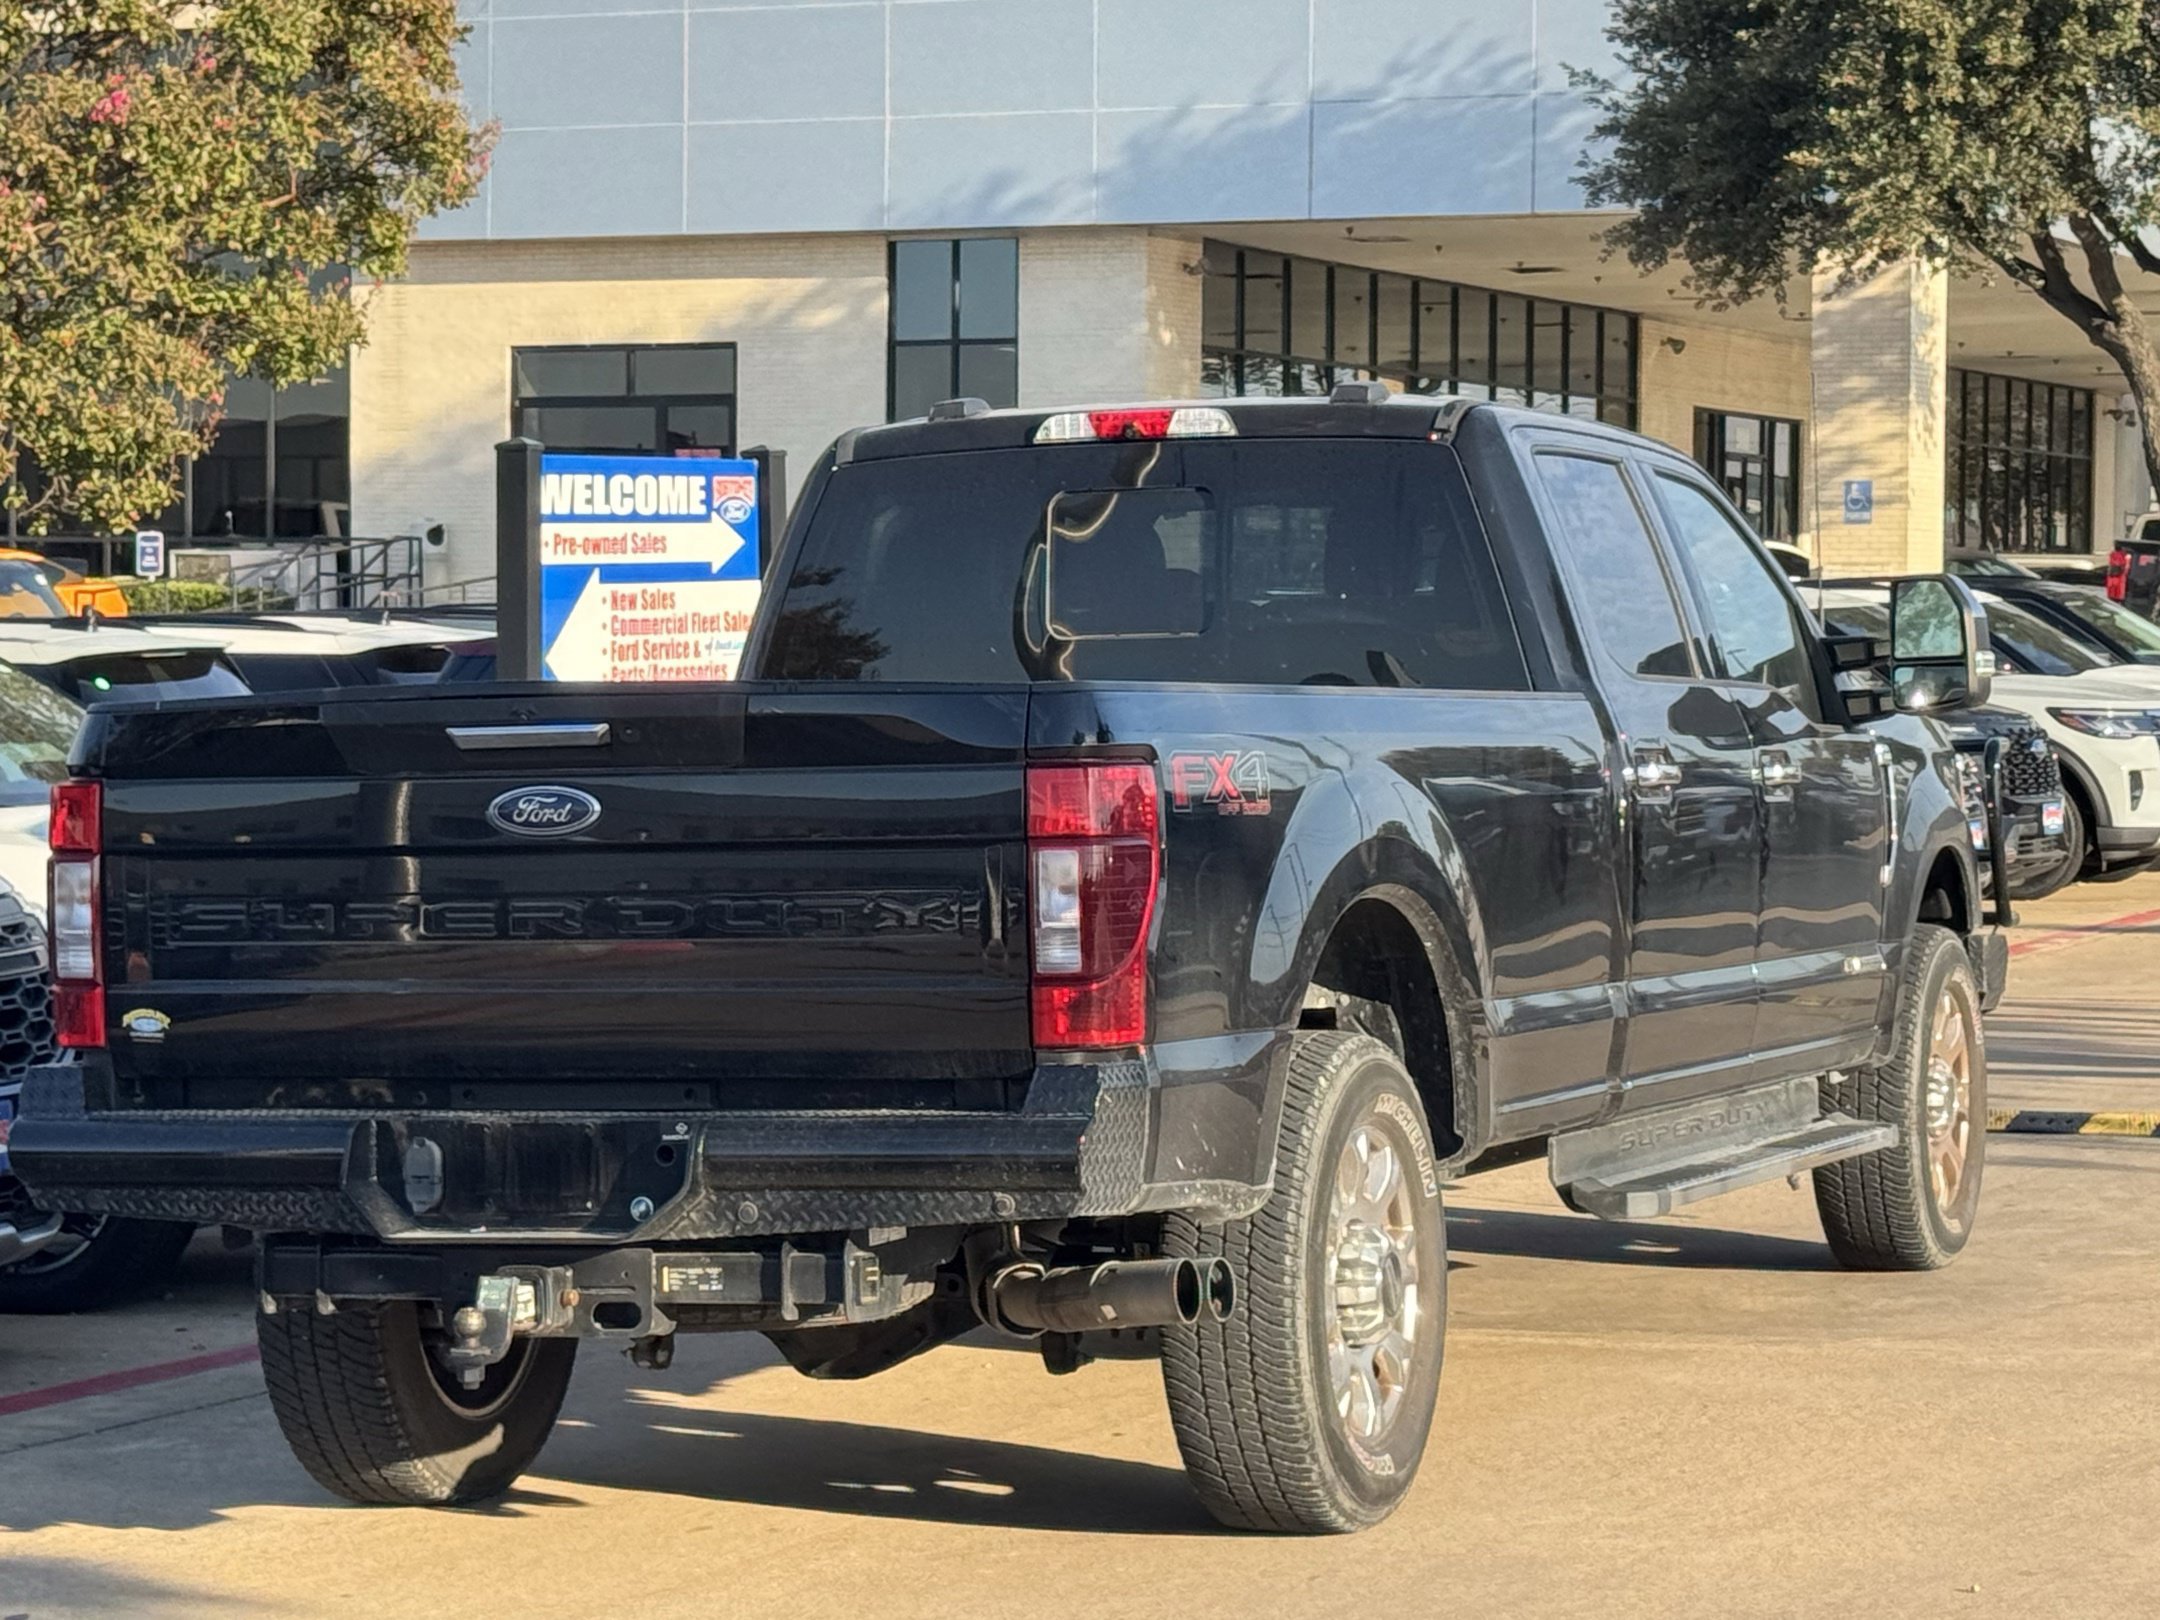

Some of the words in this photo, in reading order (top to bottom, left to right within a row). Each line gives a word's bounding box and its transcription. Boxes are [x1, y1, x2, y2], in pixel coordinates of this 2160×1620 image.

[541, 474, 707, 516] WELCOME
[553, 533, 628, 555] Pre-owned
[631, 532, 667, 554] Sales
[611, 590, 637, 611] New
[641, 588, 676, 610] Sales
[611, 613, 688, 637] Commercial
[691, 612, 721, 633] Fleet
[724, 610, 752, 632] Sale
[611, 640, 639, 661] Ford
[643, 638, 690, 660] Service
[693, 640, 702, 658] &
[1168, 751, 1271, 813] FX4
[513, 796, 573, 823] Ford
[175, 896, 588, 938] SUPER
[1620, 1117, 1704, 1151] SUPER
[1709, 1102, 1769, 1129] DUTY
[1374, 1093, 1438, 1198] MICHELIN
